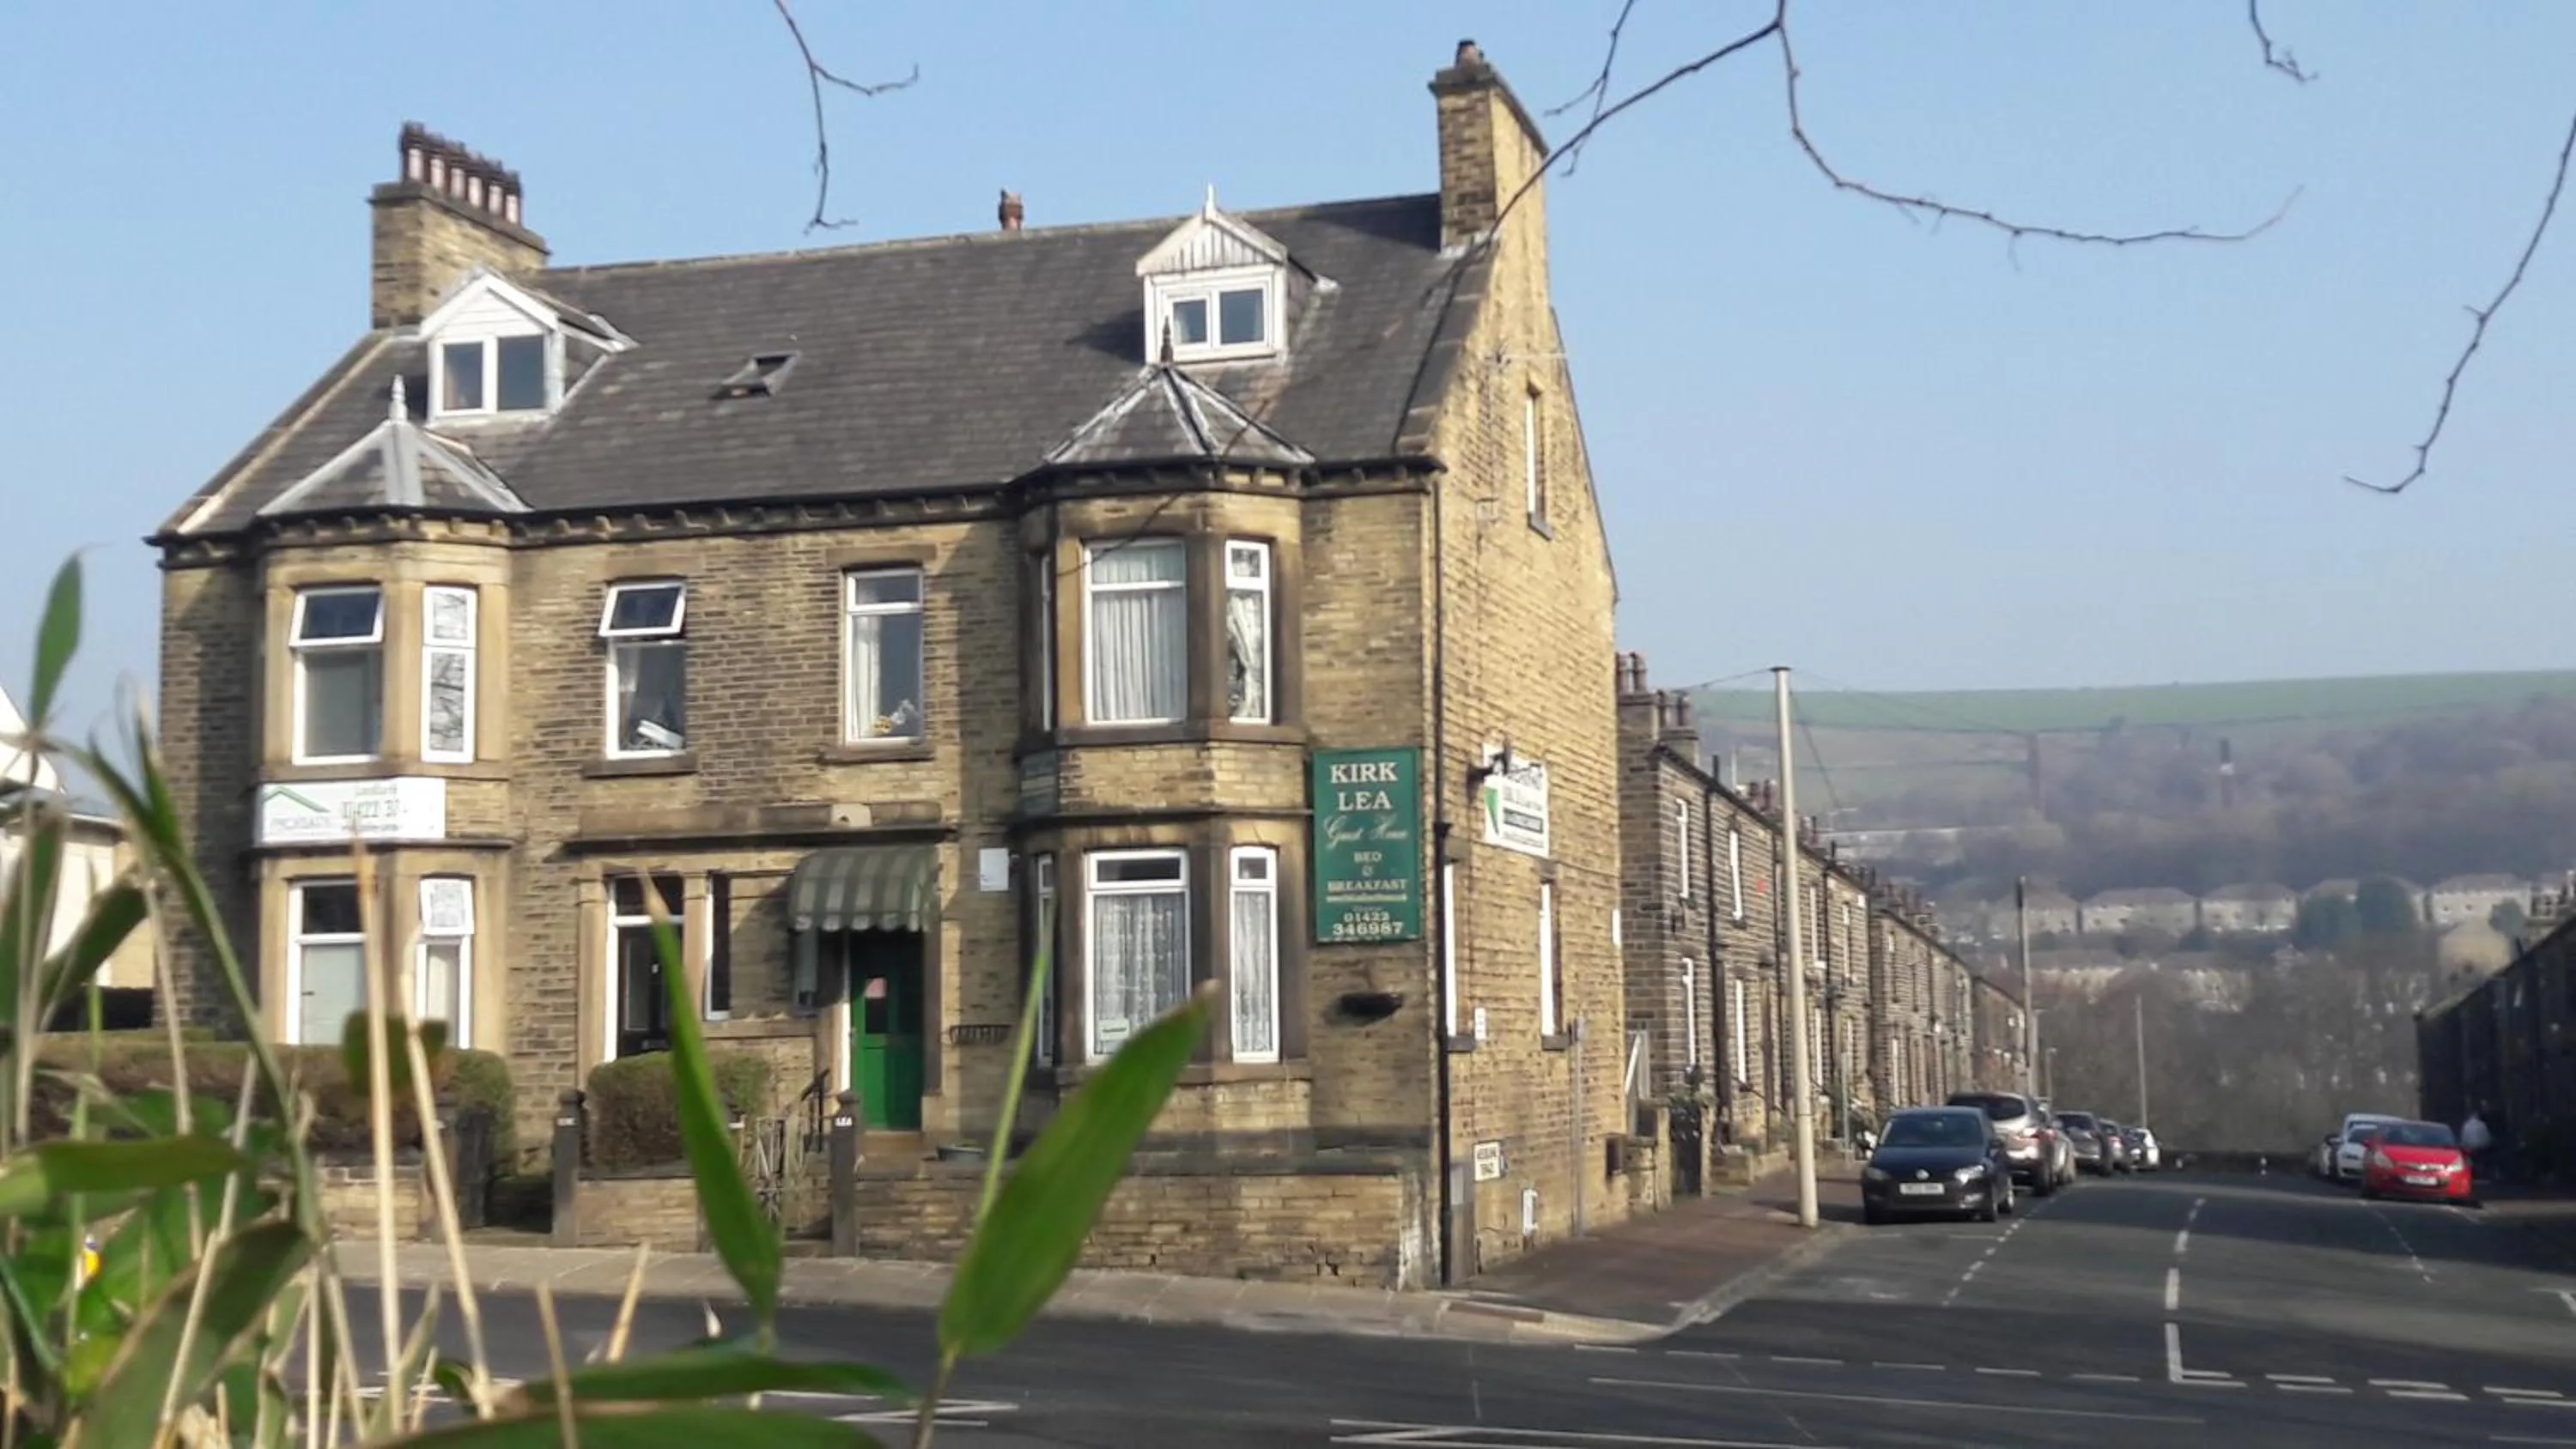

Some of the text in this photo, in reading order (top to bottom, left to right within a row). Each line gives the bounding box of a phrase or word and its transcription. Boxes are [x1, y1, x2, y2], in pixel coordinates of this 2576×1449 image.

[1330, 761, 1398, 784] KIRK
[1338, 790, 1393, 811] LEA
[1353, 851, 1382, 863] BED
[1327, 878, 1408, 893] BREAKFAST
[1332, 921, 1405, 936] 346987
